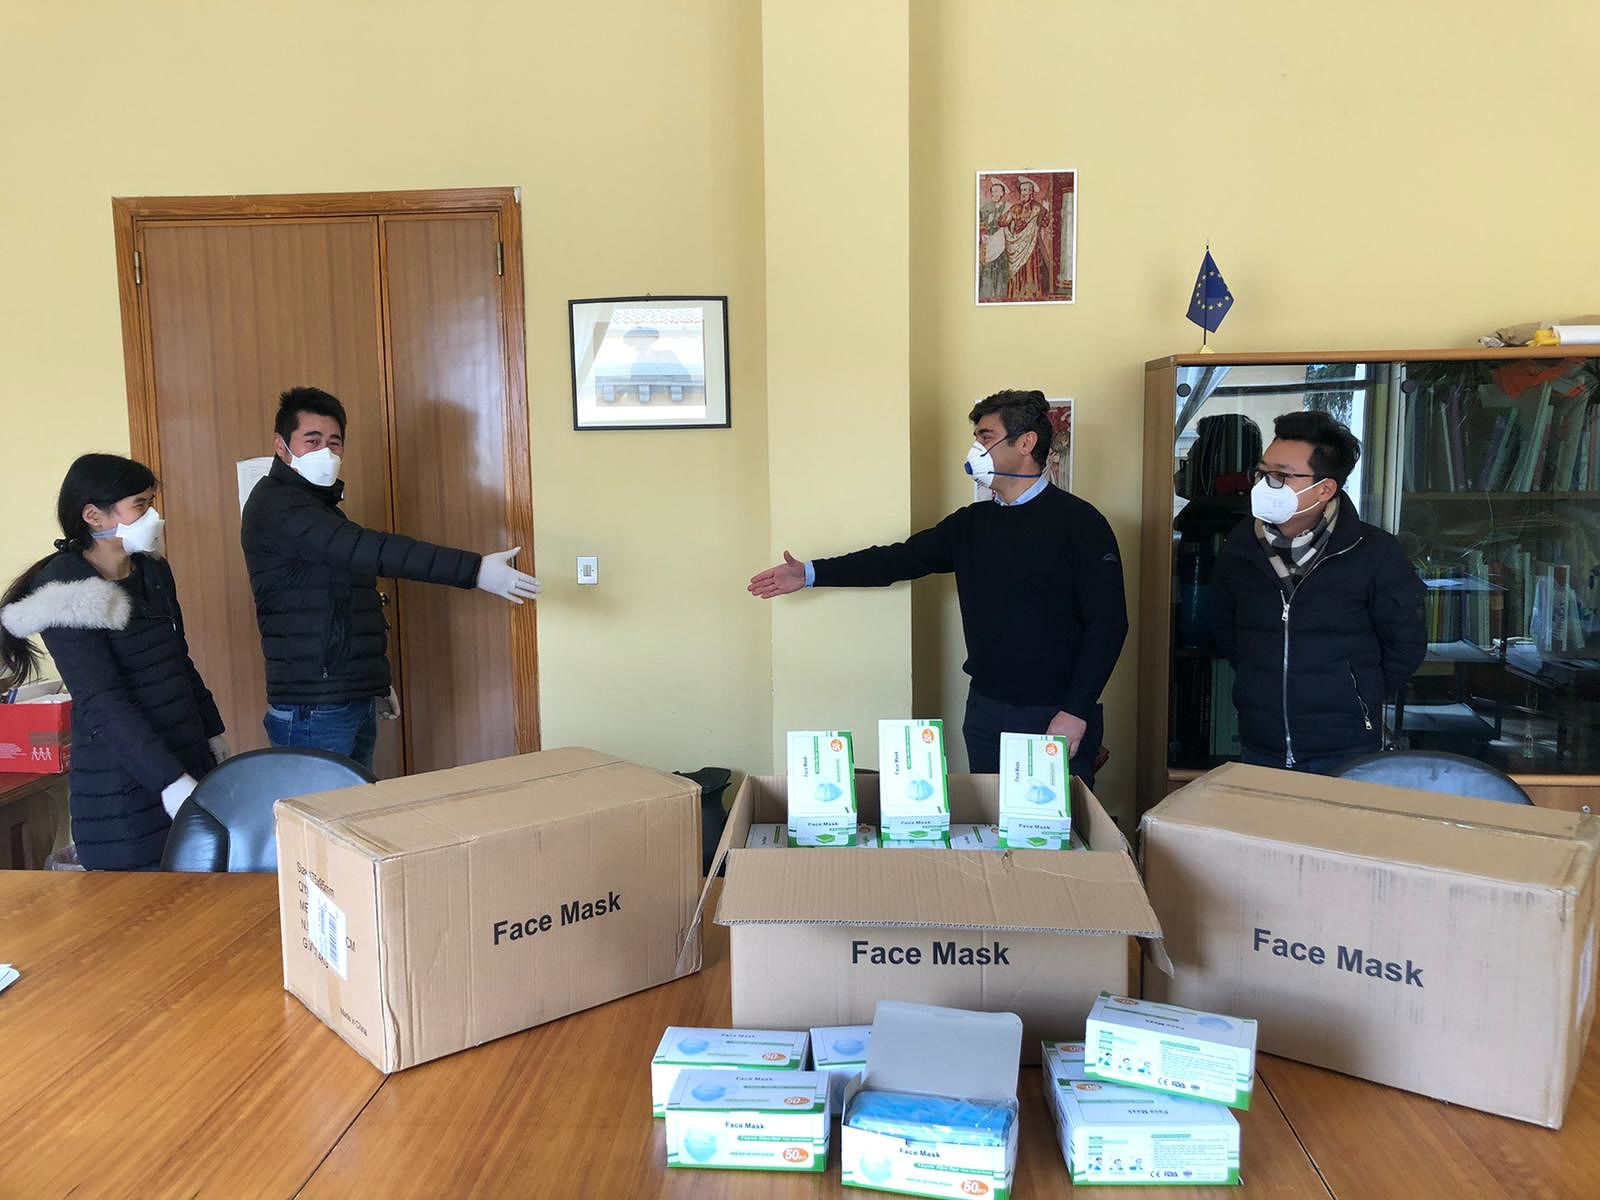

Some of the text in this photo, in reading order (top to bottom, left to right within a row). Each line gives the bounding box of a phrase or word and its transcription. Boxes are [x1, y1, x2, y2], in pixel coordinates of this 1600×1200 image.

[493, 890, 623, 946] Face Mask
[851, 940, 1011, 966] Face Mask
[1253, 928, 1425, 988] Face Mask
[725, 1121, 766, 1130] Face Mask
[899, 1148, 941, 1159] Face Mask
